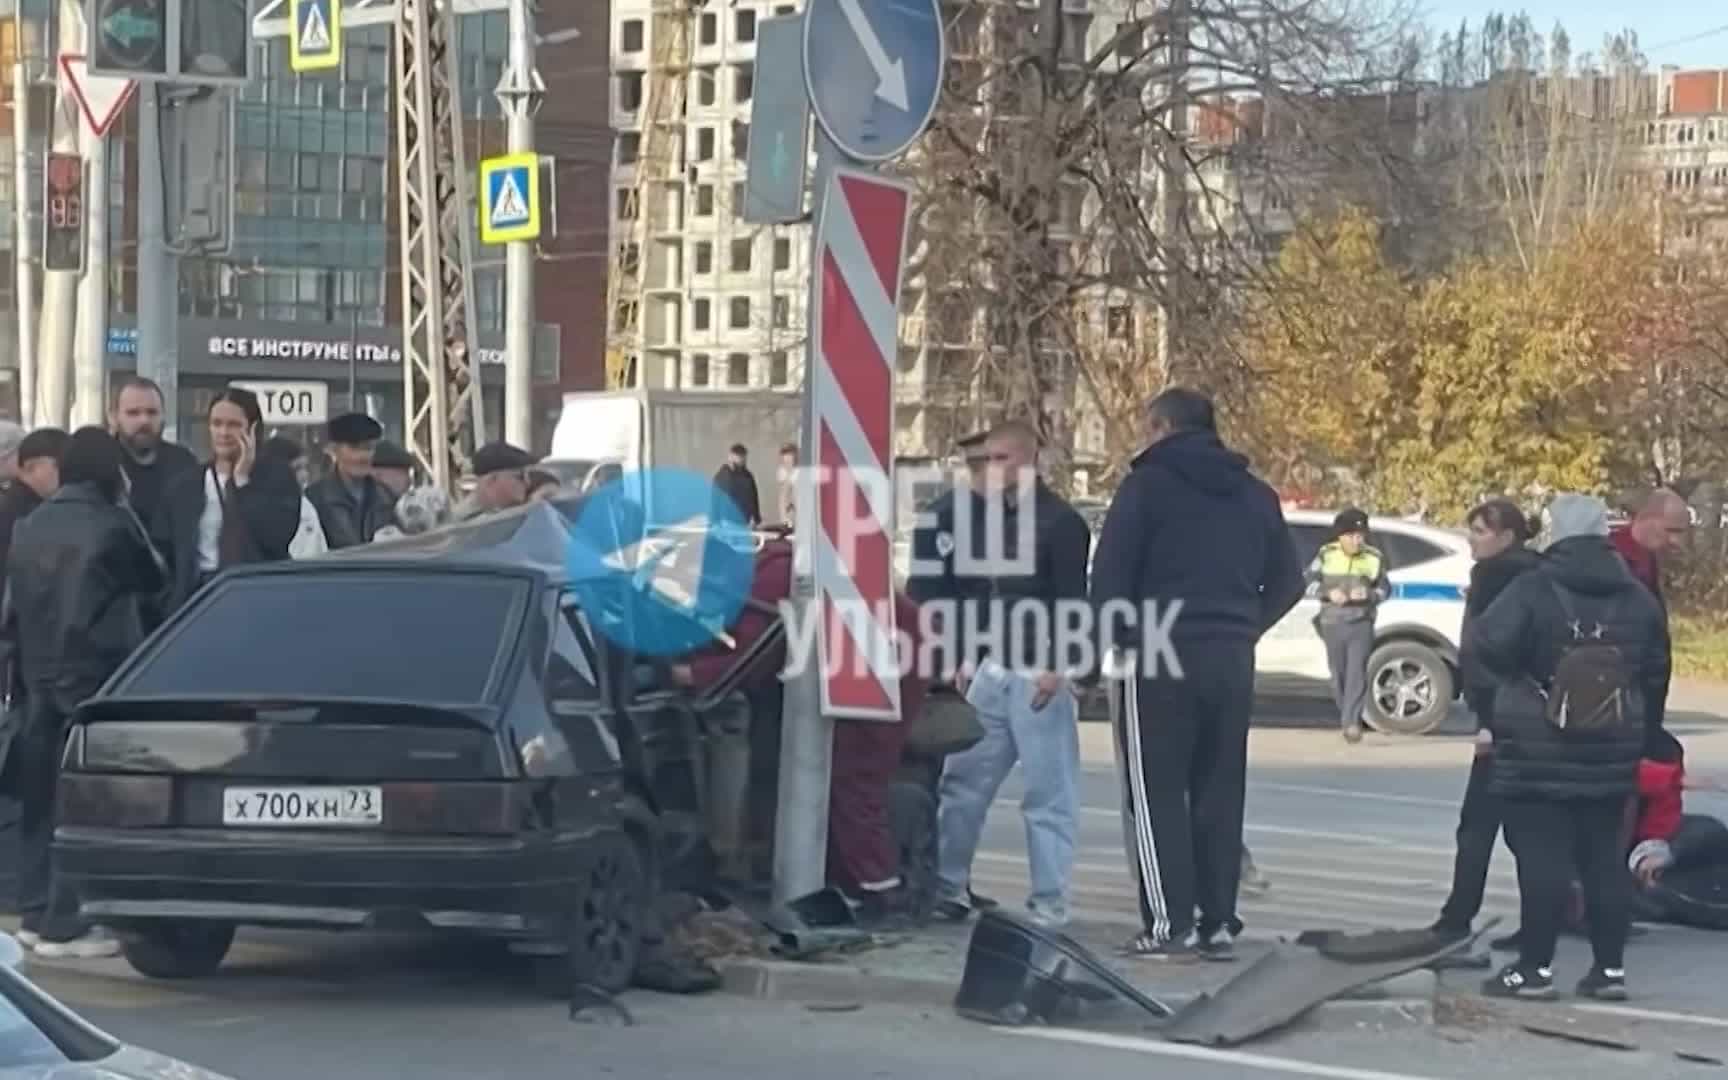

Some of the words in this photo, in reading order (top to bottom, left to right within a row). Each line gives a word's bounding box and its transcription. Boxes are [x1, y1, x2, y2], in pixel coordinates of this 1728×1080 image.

[208, 336, 248, 357] ВСЕ
[264, 390, 312, 415] ТОП
[348, 789, 373, 811] 73
